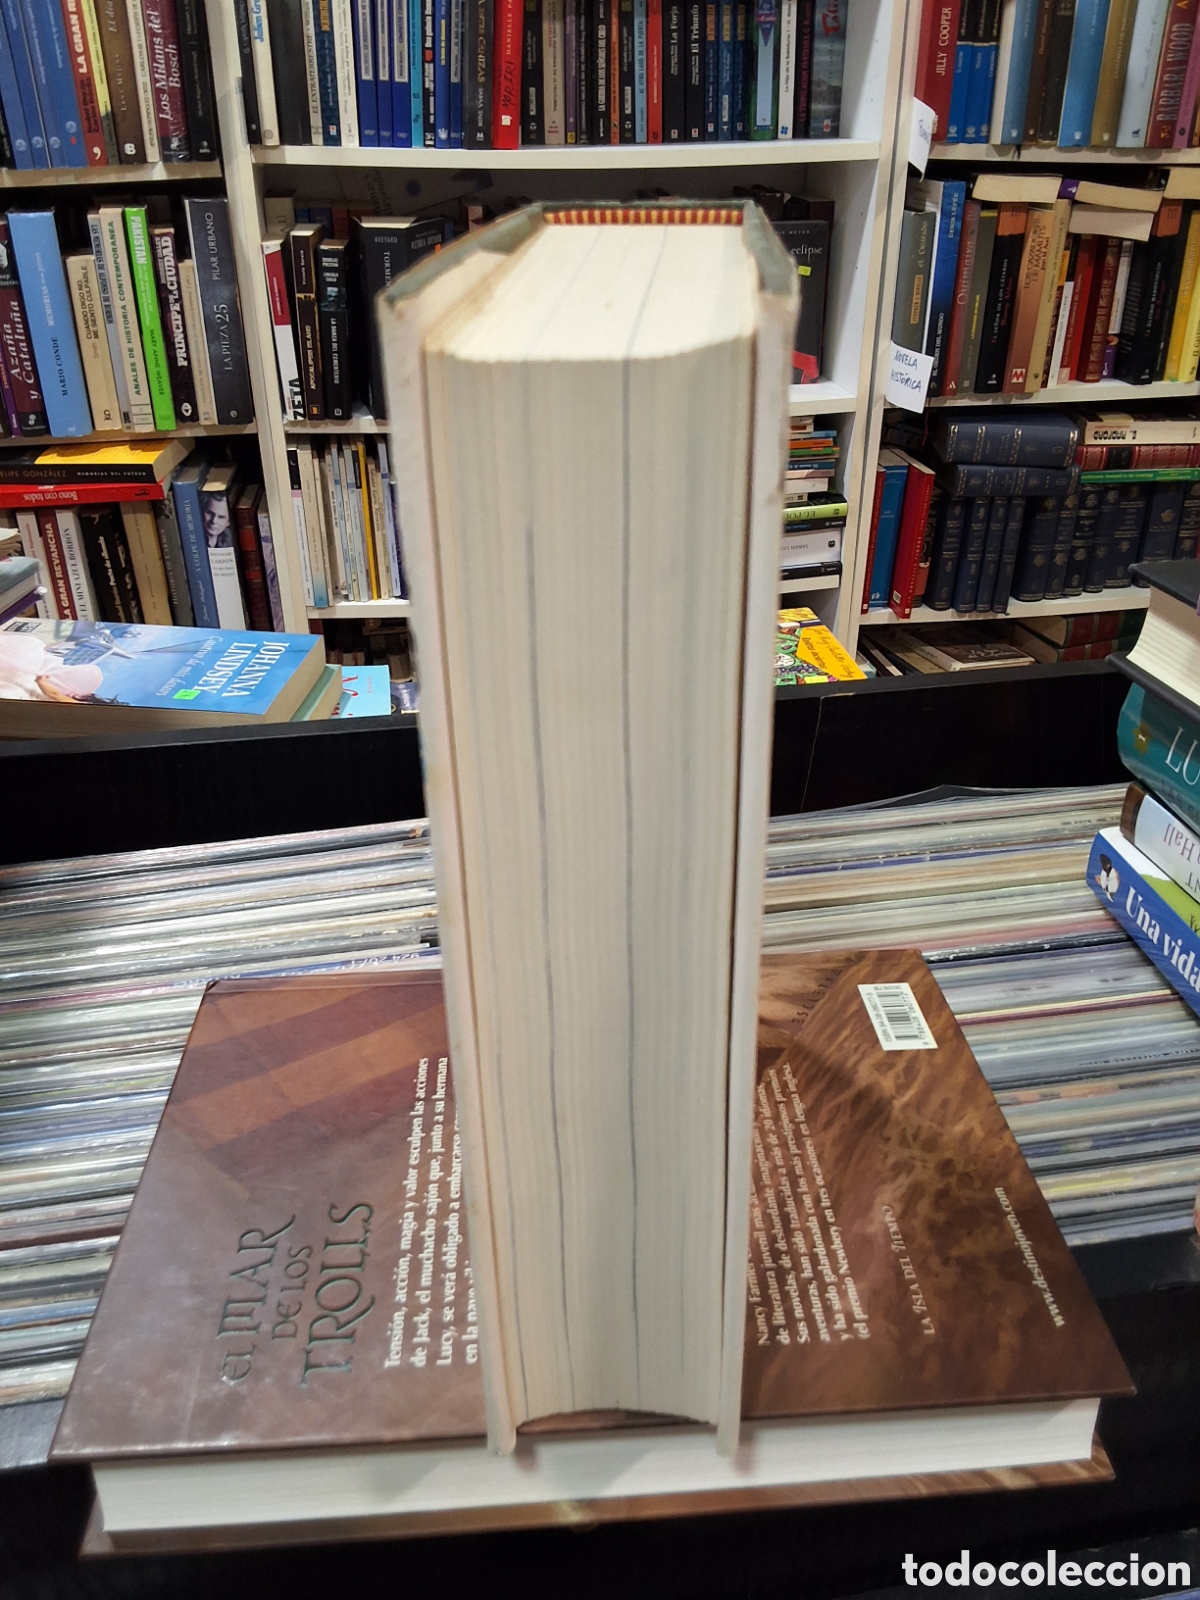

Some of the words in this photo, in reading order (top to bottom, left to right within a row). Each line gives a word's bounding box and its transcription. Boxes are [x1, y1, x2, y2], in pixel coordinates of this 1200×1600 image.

[108, 20, 117, 32] El
[147, 10, 162, 32] del
[670, 6, 679, 30] Forja
[690, 5, 700, 41] Triunfo
[938, 7, 952, 46] COOPER
[72, 14, 84, 53] GRAN
[671, 32, 678, 43] La
[691, 44, 700, 52] El
[1166, 22, 1194, 63] WOOD
[78, 57, 88, 74] LA
[152, 36, 168, 89] Milans
[166, 44, 181, 88] Bosch
[478, 37, 486, 83] CENIZAS
[936, 50, 948, 76] JILLY
[158, 92, 171, 120] Los
[1156, 61, 1185, 122] BARBARA
[131, 216, 147, 264] PAKISTAN
[205, 212, 218, 254] URBANO
[1032, 225, 1046, 268] MAMUTS
[108, 220, 126, 302] CONTEMPORANEA
[162, 236, 178, 291] CIUDAD
[211, 256, 220, 280] PILAR
[790, 245, 823, 264] eclipse
[80, 266, 93, 302] CULPABLE
[1024, 272, 1032, 288] LOS
[40, 285, 55, 326] MEMORIAS
[79, 292, 88, 310] DIGO
[88, 304, 97, 328] SIENTO
[214, 304, 230, 324] 25
[82, 310, 92, 340] CUANDO
[92, 329, 99, 338] ME
[121, 304, 132, 344] HISTORIA
[170, 302, 188, 366] PRINCIPE
[219, 324, 231, 354] PIEZA
[305, 325, 314, 348] ISLAND
[2, 323, 22, 380] Azaña
[10, 300, 35, 384] Cataluña
[51, 336, 62, 366] CONDE
[92, 342, 100, 358] Smith
[127, 347, 134, 358] DE
[224, 357, 234, 370] LA
[894, 350, 918, 370] NOVELA
[58, 368, 68, 396] MARIO
[130, 362, 141, 396] ANALES
[156, 370, 164, 396] WEAVER
[30, 390, 40, 400] y
[290, 378, 305, 420] ZETA
[23, 468, 67, 478] GONZÁLEZ
[24, 493, 44, 502] todos
[44, 492, 58, 500] con
[58, 490, 78, 500] Bono
[44, 523, 65, 578] REVANCHA
[63, 528, 76, 560] BORBÓN
[191, 544, 200, 566] GOLPE
[57, 580, 68, 606] GRAN
[62, 608, 72, 620] LA
[196, 636, 224, 658] Cautivo
[194, 642, 258, 694] LINDSEY
[222, 640, 290, 698] JOHANNA
[1163, 822, 1193, 862] Hall
[1124, 886, 1161, 944] Una
[1163, 934, 1200, 993] vida
[882, 1028, 892, 1042] ISBN
[413, 1057, 429, 1099] acciones
[431, 1057, 448, 1099] hermana
[767, 1069, 787, 1102] premios
[781, 1062, 798, 1092] inglesa.
[410, 1100, 425, 1116] las
[434, 1101, 445, 1113] su
[756, 1082, 771, 1117] idiomas,
[790, 1093, 806, 1122] lengua
[428, 1124, 445, 1153] junto
[764, 1119, 775, 1130] 20
[768, 1133, 778, 1145] de
[776, 1102, 802, 1154] prestigiosos
[799, 1123, 810, 1135] en
[407, 1117, 426, 1166] esculpen
[770, 1146, 784, 1166] más
[428, 1155, 444, 1181] que,
[447, 1134, 462, 1199] embarcarse
[790, 1156, 804, 1175] más
[802, 1136, 825, 1186] ocasiones)
[402, 1168, 418, 1198] valor
[797, 1178, 809, 1192] los
[818, 1187, 832, 1207] tres
[404, 1200, 420, 1209] y
[423, 1184, 442, 1216] sajón
[449, 1202, 460, 1210] a
[778, 1176, 800, 1229] traducidas
[802, 1194, 815, 1214] con
[398, 1212, 418, 1250] magia
[764, 1187, 788, 1251] desbordante
[823, 1209, 836, 1223] en
[882, 1205, 906, 1253] TIEMPO
[418, 1218, 436, 1286] muchacho
[441, 1212, 463, 1268] obligado
[754, 1231, 777, 1268] juvenil
[790, 1230, 807, 1253] sido
[806, 1216, 838, 1283] galardonada
[829, 1224, 851, 1275] Newbery
[280, 1245, 314, 1293] LOS
[778, 1253, 792, 1269] de
[800, 1256, 814, 1278] han
[900, 1255, 917, 1279] DEL
[994, 1186, 1065, 1328] www.destinojoven.com
[216, 1214, 296, 1340] MAR
[393, 1253, 413, 1303] acción,
[440, 1272, 457, 1302] verá
[747, 1262, 761, 1303] Farmer
[300, 1202, 377, 1390] TROLLS
[415, 1290, 431, 1304] el
[765, 1270, 786, 1326] literatura
[785, 1270, 805, 1318] novelas,
[827, 1285, 843, 1310] sido
[842, 1277, 869, 1320] premio
[909, 1282, 927, 1314] ISLA
[271, 1300, 302, 1341] DE
[412, 1307, 433, 1344] Jack,
[441, 1306, 455, 1322] se
[754, 1305, 770, 1346] Nancy
[808, 1280, 830, 1342] aventuras,
[833, 1313, 847, 1330] ha
[922, 1317, 935, 1335] LA
[384, 1306, 408, 1369] Tensión,
[436, 1326, 458, 1366] Lucy,
[461, 1326, 478, 1340] la
[776, 1328, 790, 1345] de
[797, 1321, 810, 1344] Sus
[840, 1332, 854, 1341] y
[853, 1322, 871, 1340] (el
[410, 1347, 427, 1368] de
[464, 1344, 478, 1364] en
